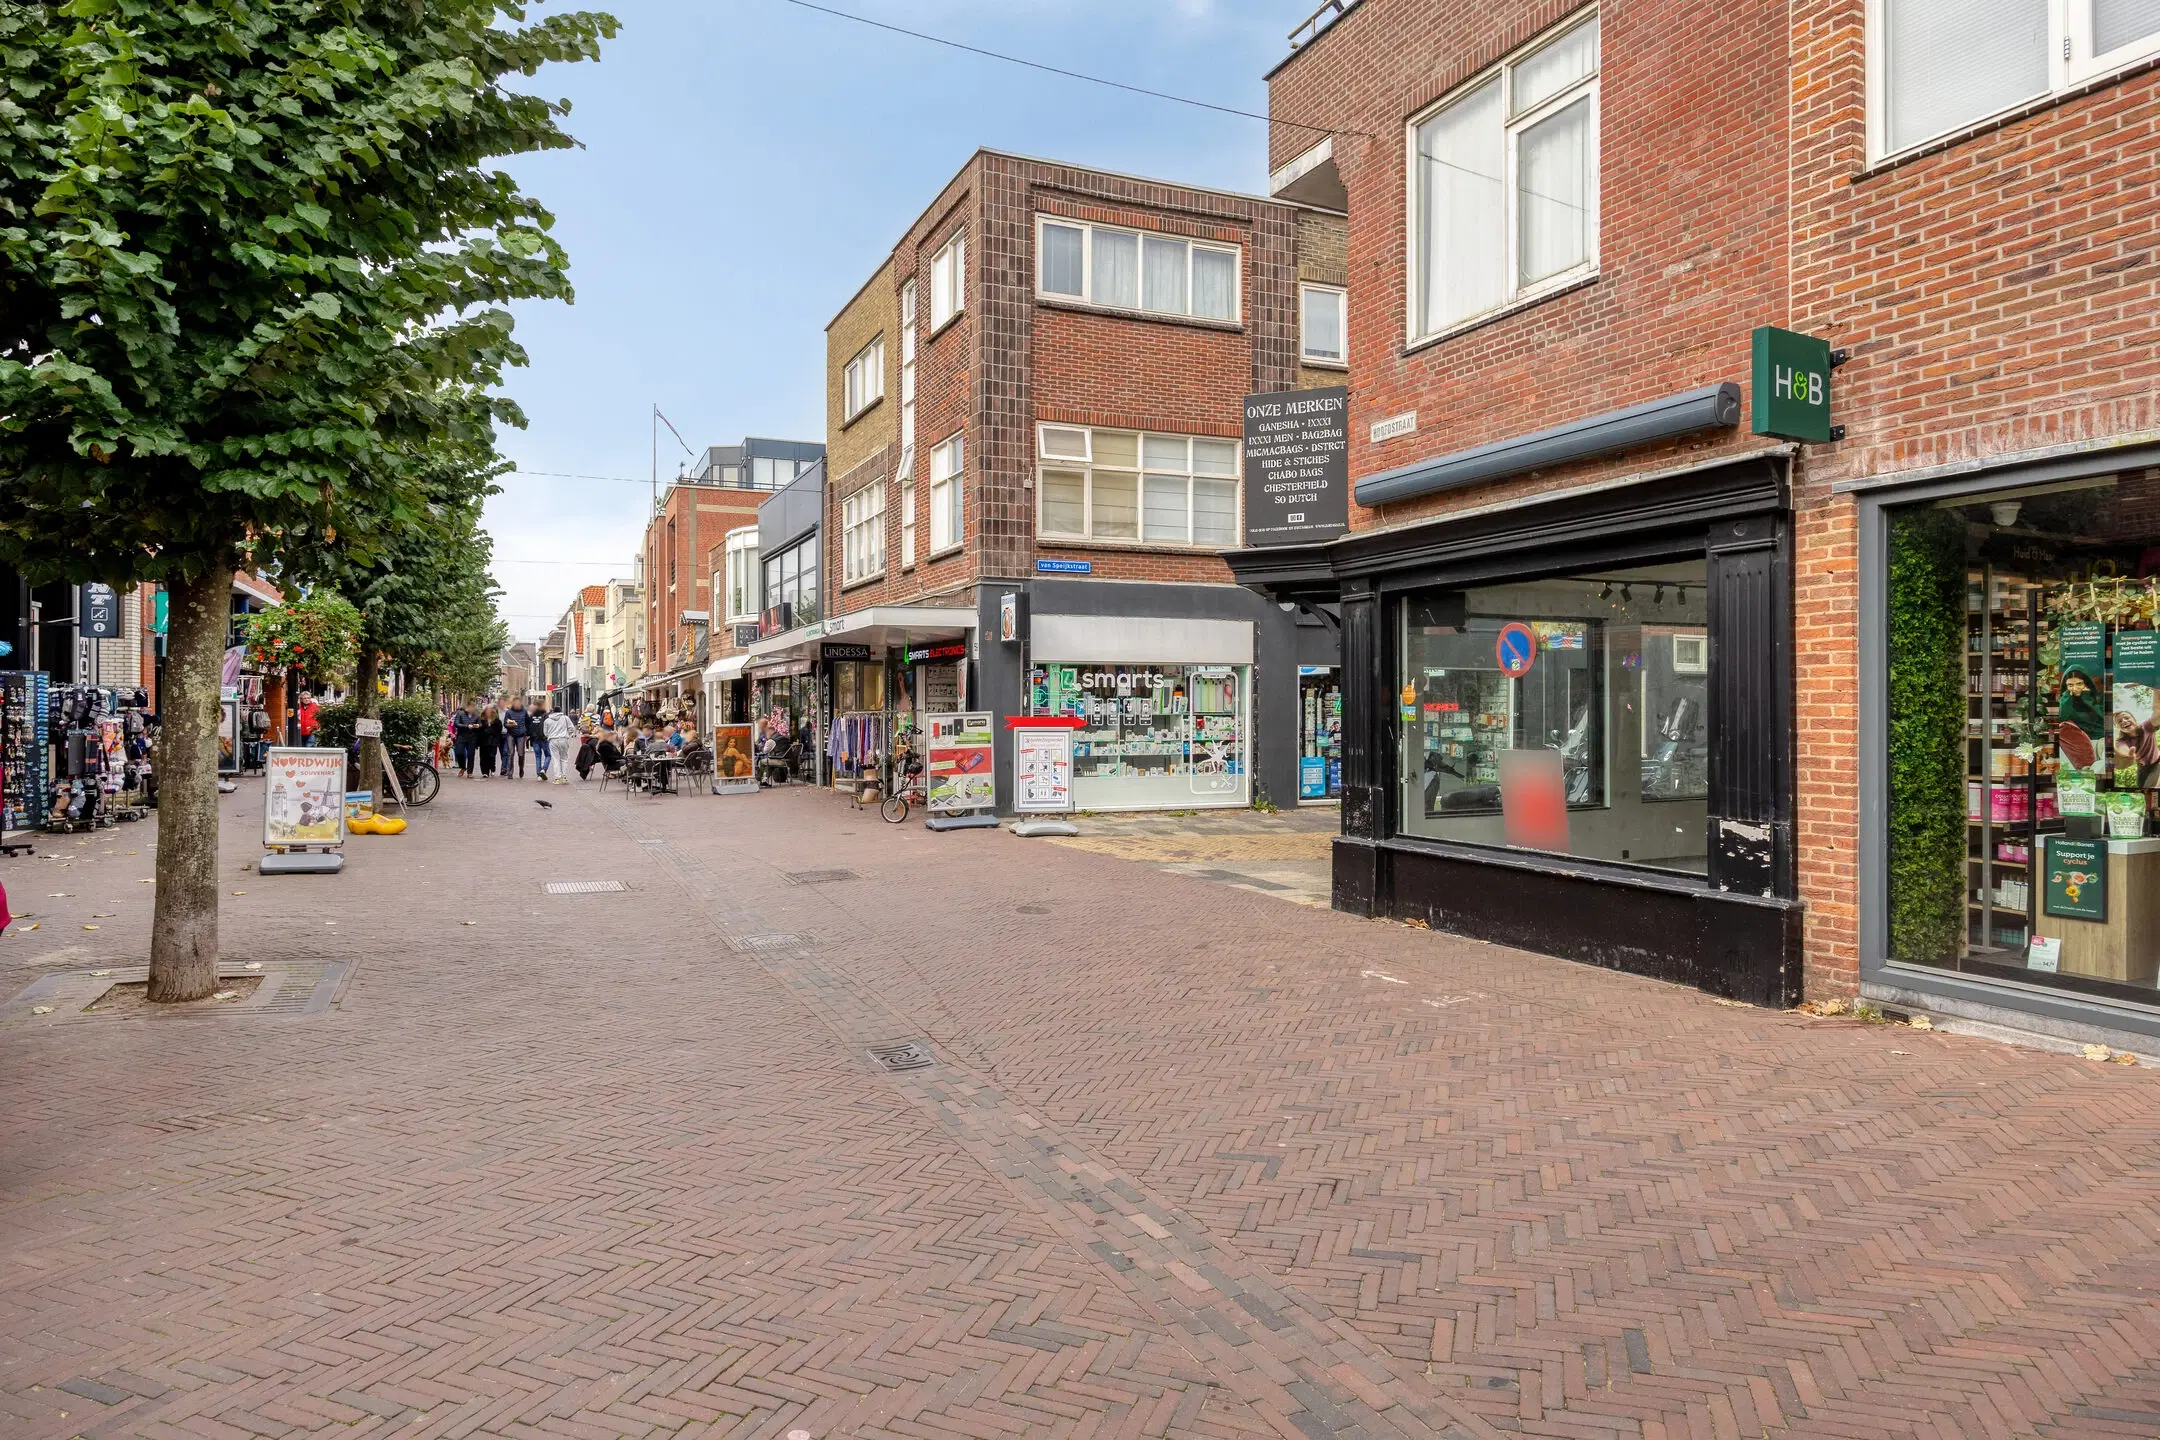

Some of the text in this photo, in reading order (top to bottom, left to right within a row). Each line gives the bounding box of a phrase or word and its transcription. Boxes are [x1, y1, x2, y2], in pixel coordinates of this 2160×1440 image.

[1776, 364, 1824, 406] H&B
[1246, 397, 1343, 419] ONZE MERKEN
[1259, 417, 1331, 432] GANESHA IXXXI
[1372, 416, 1414, 438] HOOFDSTRAAT
[1248, 428, 1342, 446] IXXXI MEN BAG2BAG
[1246, 440, 1346, 458] MICMACBAGS DSTRCT
[1262, 458, 1282, 469] HIDE
[1294, 455, 1330, 466] STICHES
[1268, 468, 1324, 480] CHABO BAGS
[1264, 480, 1328, 492] CHESTERFIELD
[1275, 493, 1318, 504] SO DUTCH
[824, 646, 868, 657] LINDESSA
[930, 645, 964, 658] ELECTRONICS
[1082, 671, 1164, 688] smarts
[2056, 851, 2086, 859] Support
